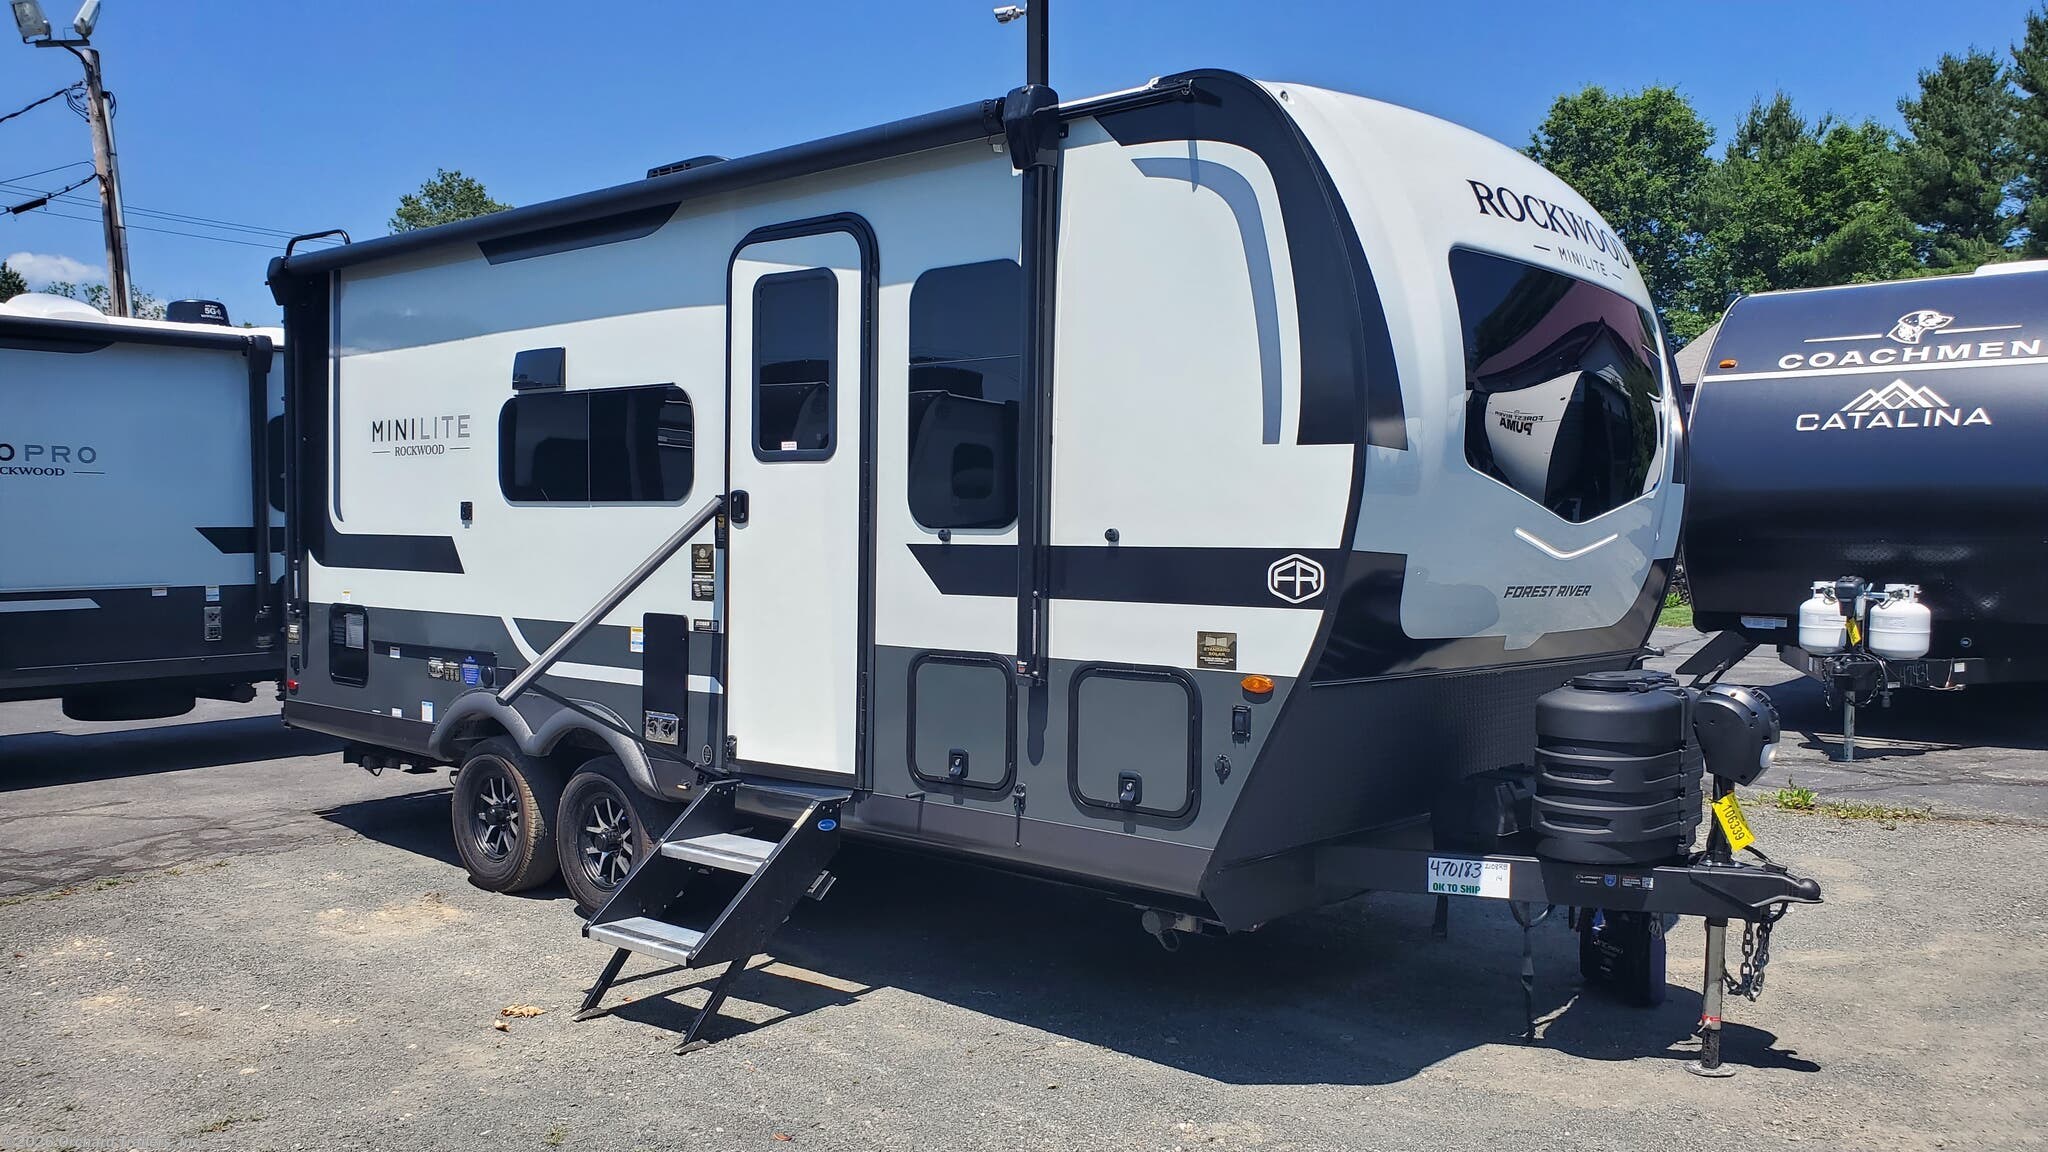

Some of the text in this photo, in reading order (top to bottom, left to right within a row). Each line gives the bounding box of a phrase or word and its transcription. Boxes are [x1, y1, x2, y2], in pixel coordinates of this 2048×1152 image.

[1466, 179, 1630, 269] ROCKWOOD
[1558, 247, 1608, 276] MINILITE
[1778, 340, 2041, 370] COACHMEN
[372, 415, 471, 442] MINILITE
[1796, 407, 1992, 431] CATALINA
[24, 444, 97, 464] PRO
[394, 444, 445, 456] ROCKWOOD
[1503, 585, 1592, 598] FOREST RIVER
[1722, 804, 1745, 841] 106339
[1430, 860, 1482, 878] 470183
[1433, 882, 1481, 894] OK TO SHIP
